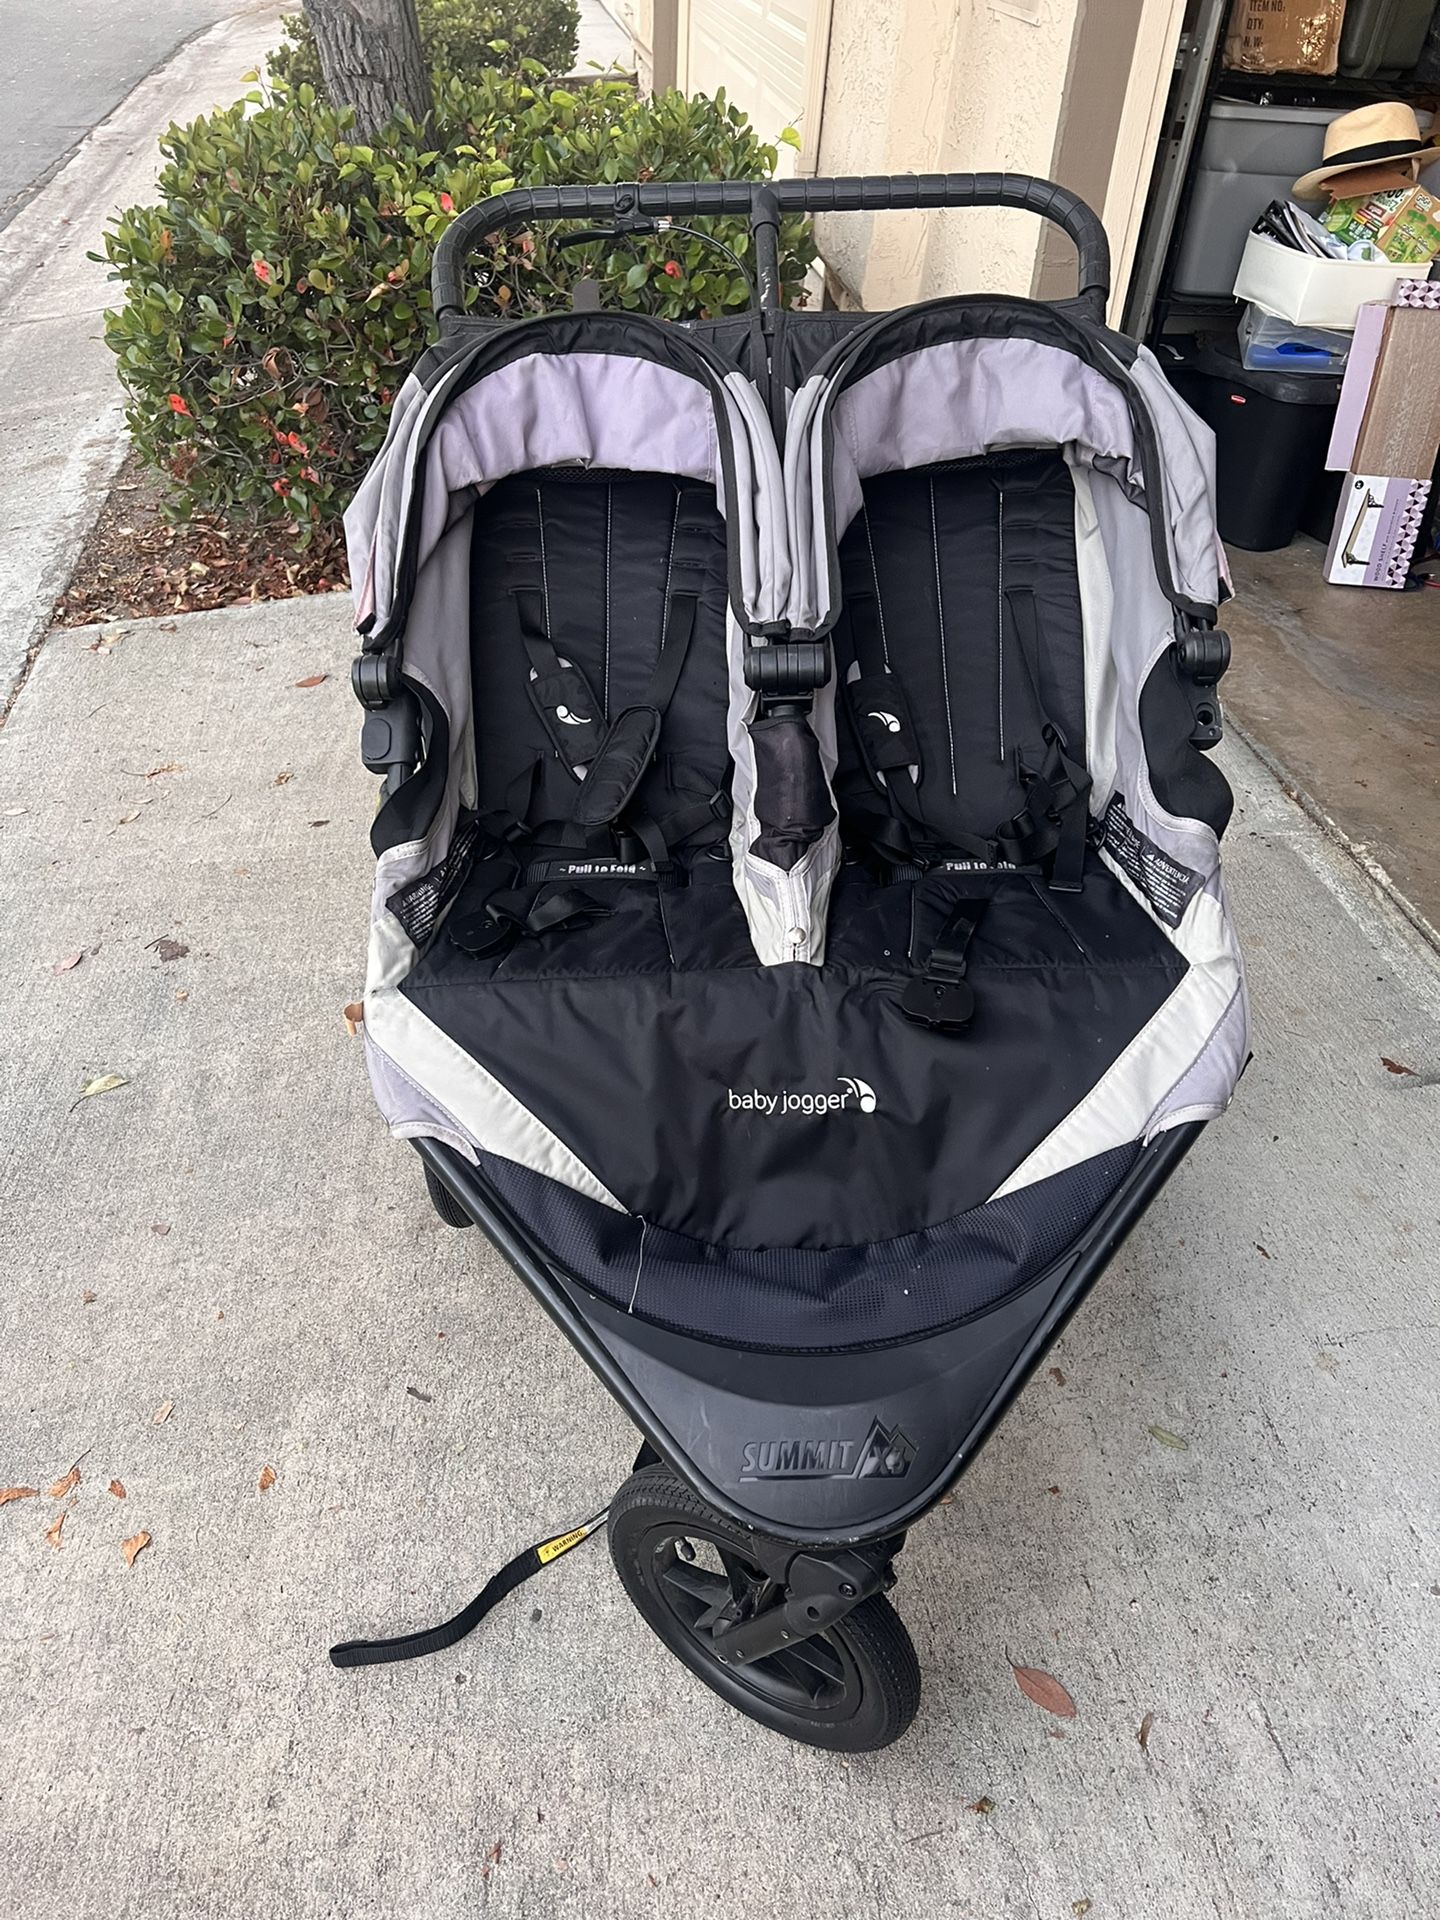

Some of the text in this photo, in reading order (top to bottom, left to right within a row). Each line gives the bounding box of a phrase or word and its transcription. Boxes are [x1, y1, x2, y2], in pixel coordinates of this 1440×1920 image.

[1249, 0, 1269, 12] ITEM
[567, 864, 636, 874] Pull to Fold
[946, 861, 972, 871] Pull
[974, 861, 987, 870] to
[728, 1088, 849, 1115] baby jogger
[741, 1440, 855, 1472] SUMMIT
